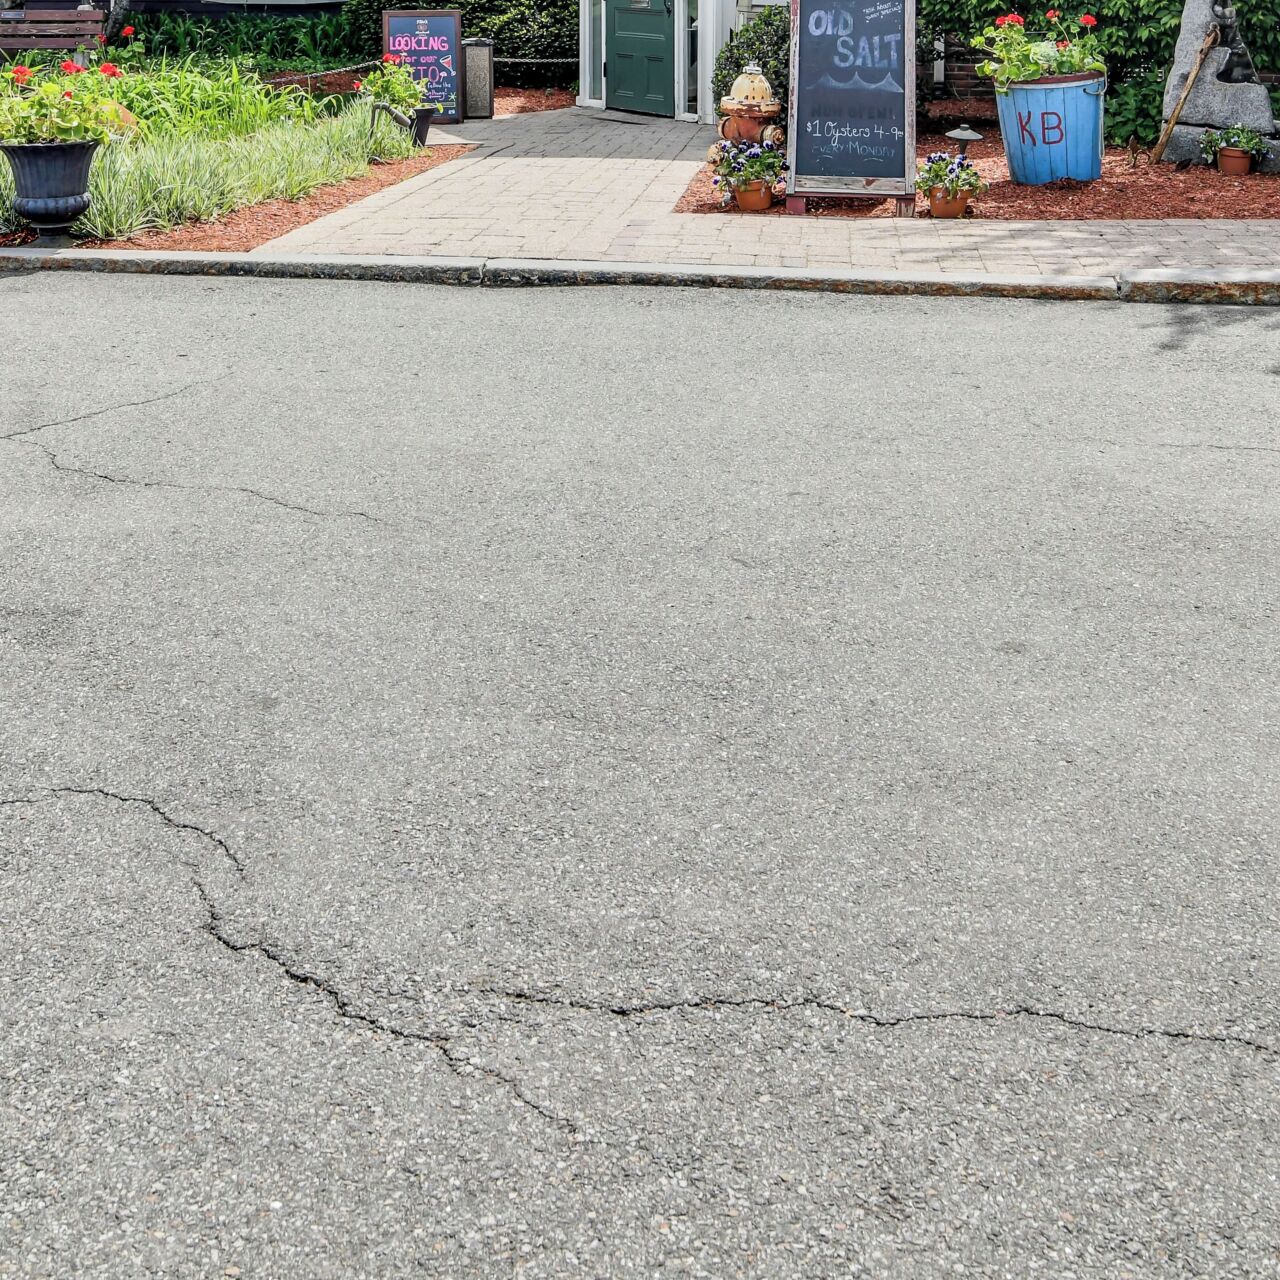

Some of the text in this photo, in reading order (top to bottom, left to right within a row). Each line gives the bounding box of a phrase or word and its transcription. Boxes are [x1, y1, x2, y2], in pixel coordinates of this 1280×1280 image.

[808, 9, 854, 36] OLD
[389, 36, 449, 51] LOOKING
[833, 33, 902, 68] SALT
[806, 120, 822, 137] $1
[824, 121, 870, 146] Oysters
[1017, 110, 1065, 147] KB
